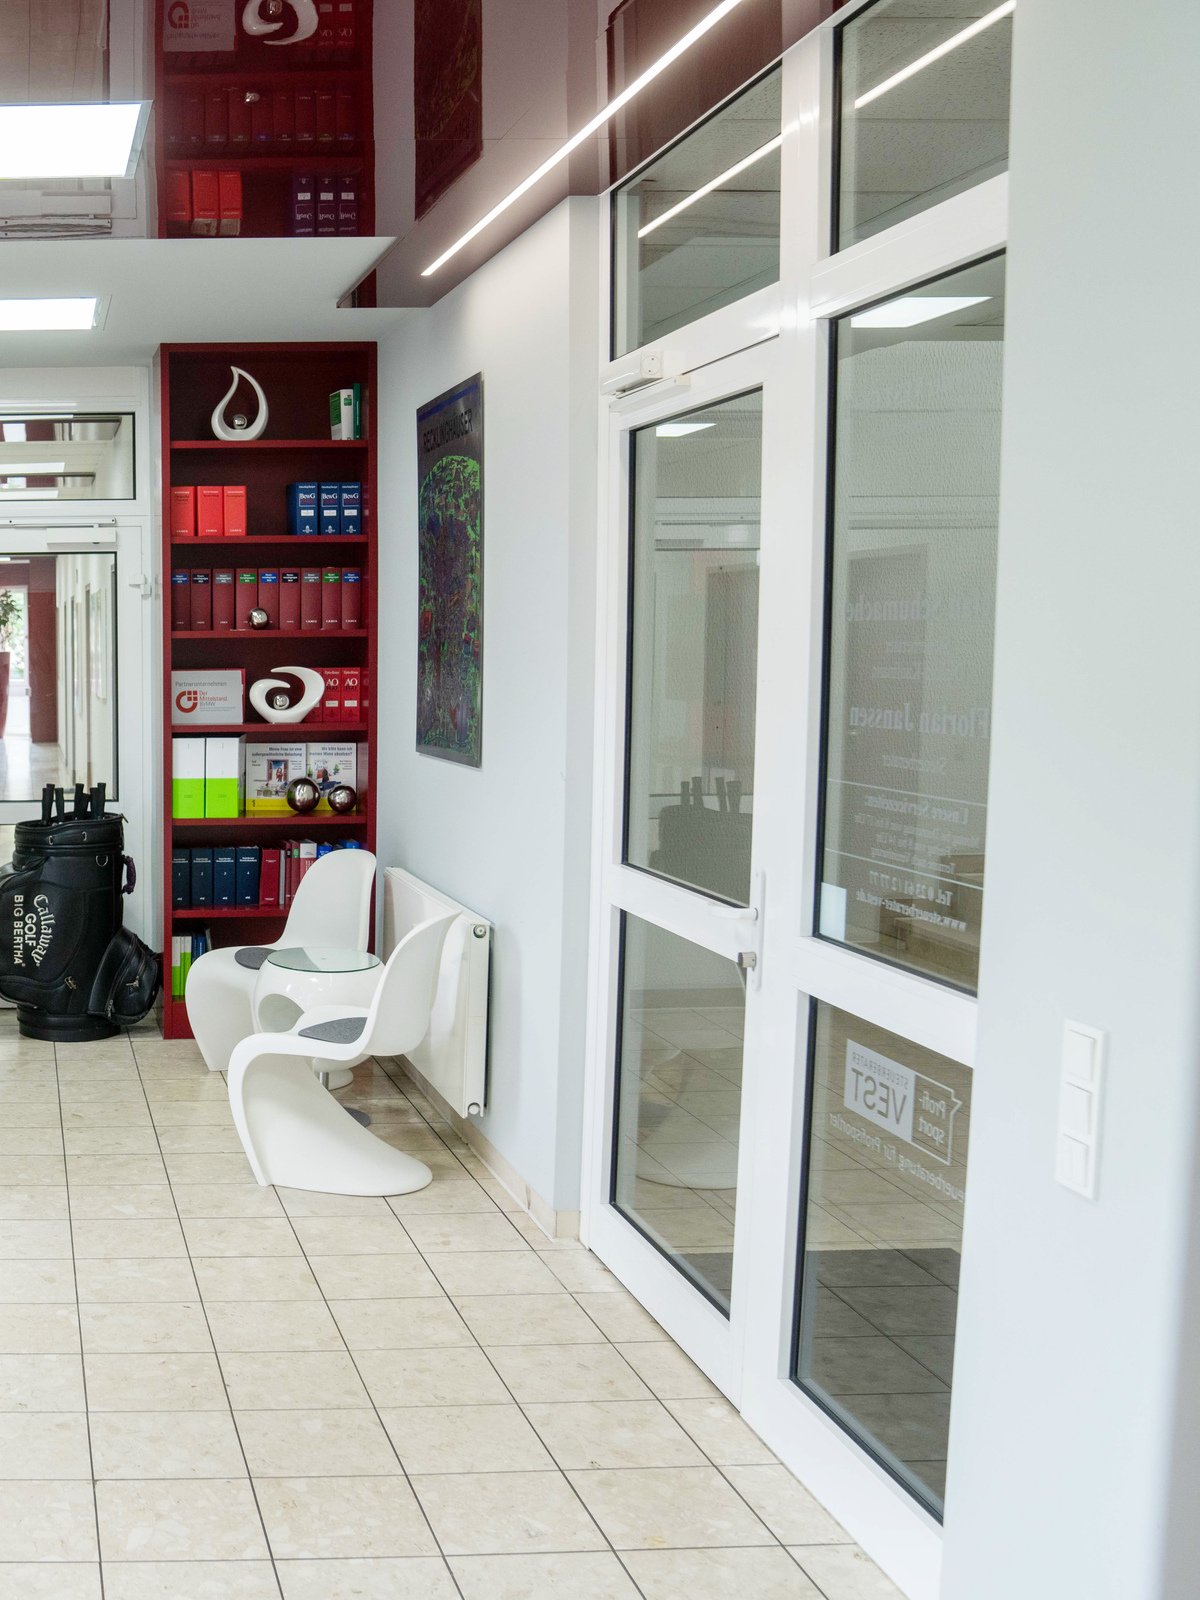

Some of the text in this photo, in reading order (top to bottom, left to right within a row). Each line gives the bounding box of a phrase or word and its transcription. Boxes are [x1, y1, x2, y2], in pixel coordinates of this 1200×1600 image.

[326, 678, 339, 686] AO
[344, 678, 358, 686] AO
[13, 894, 24, 964] BIG BERTHA
[24, 913, 37, 947] GOLF
[31, 894, 56, 964] Callaway
